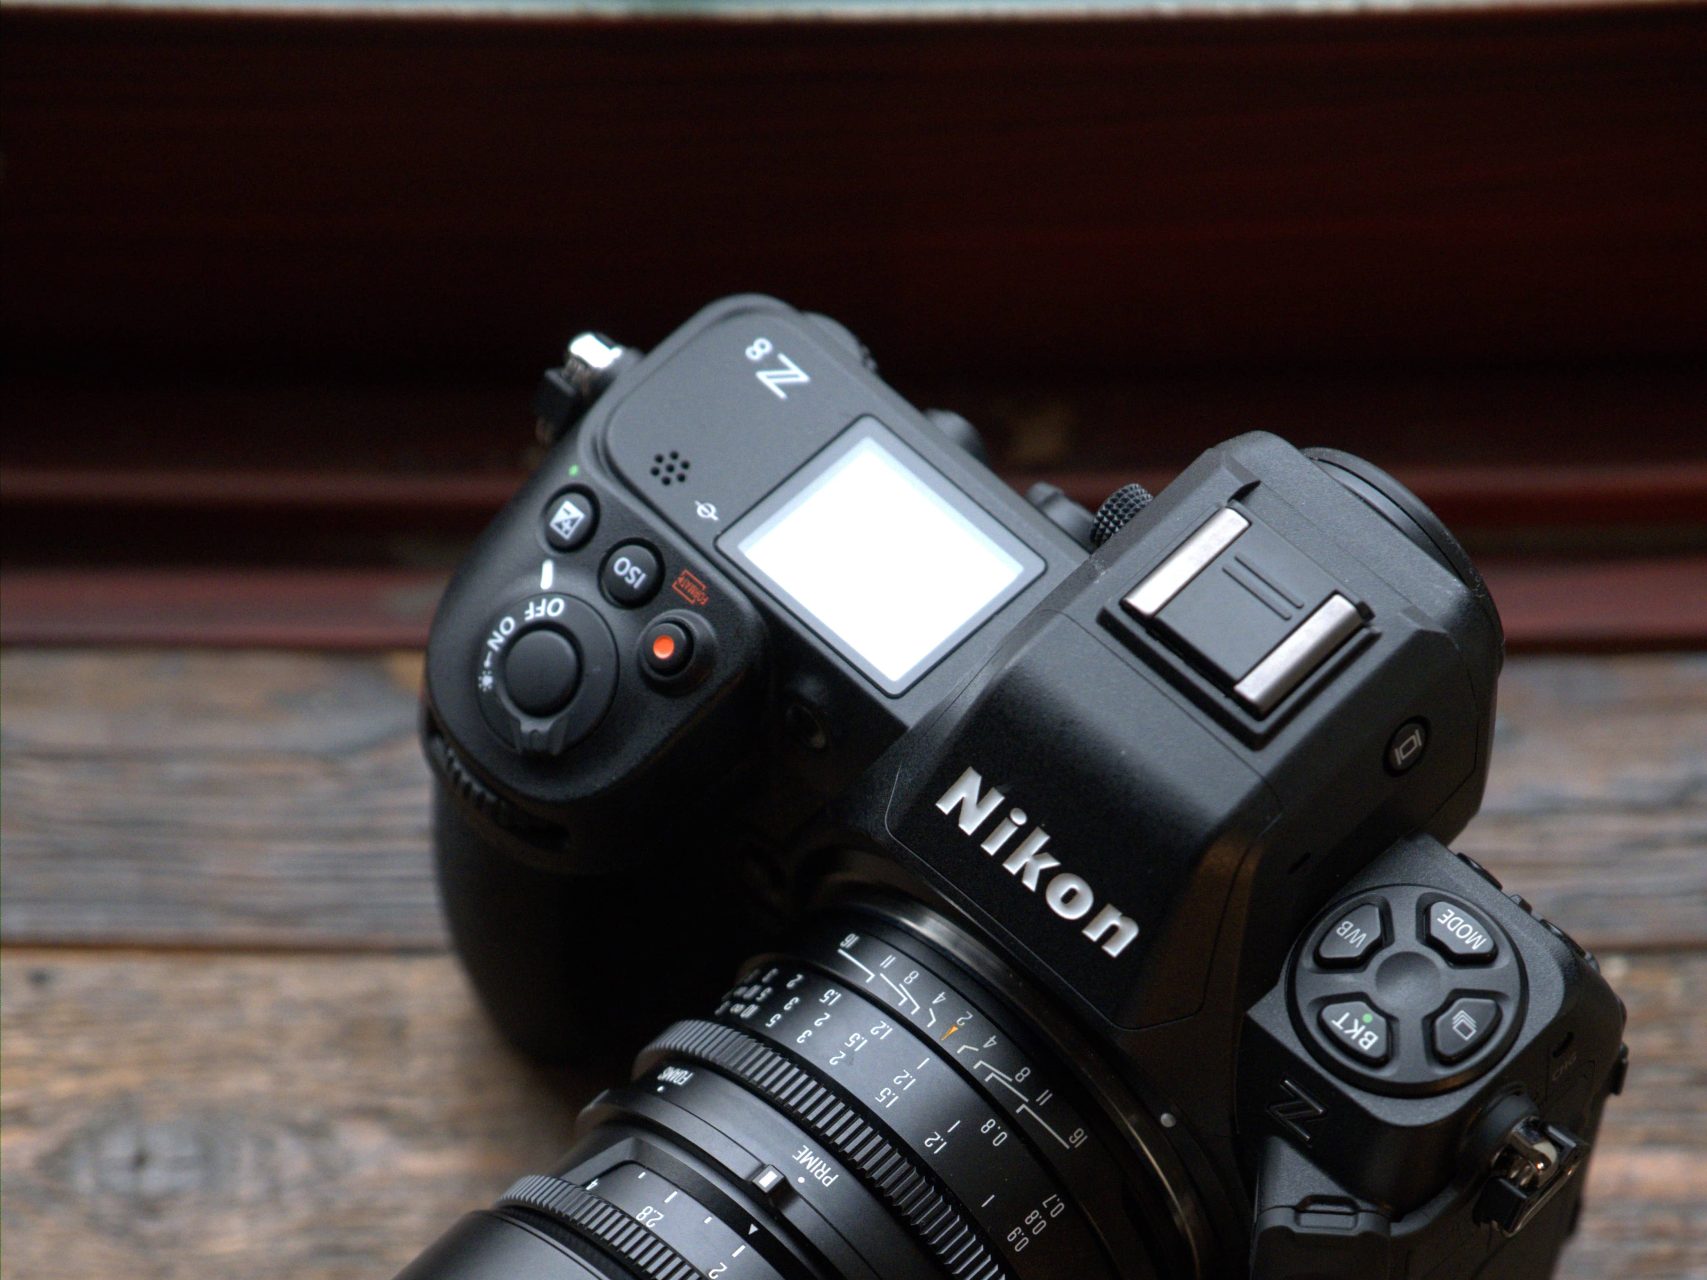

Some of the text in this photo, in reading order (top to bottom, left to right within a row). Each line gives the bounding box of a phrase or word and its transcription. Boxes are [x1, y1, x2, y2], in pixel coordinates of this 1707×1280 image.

[613, 556, 647, 589] ISO
[486, 598, 565, 651] OFF ON
[935, 766, 1140, 958] Nikon
[1336, 920, 1367, 949] WB
[1436, 908, 1487, 950] MODE
[903, 970, 920, 985] 8
[932, 991, 946, 1005] 4
[956, 1011, 974, 1026] 2
[982, 1035, 997, 1048] 4
[1014, 1066, 1031, 1083] 8
[1068, 1127, 1088, 1149] 16
[1332, 1012, 1379, 1051] BKT
[783, 996, 799, 1011] 3
[814, 1012, 831, 1027] 2
[844, 1032, 868, 1052] 1.5
[893, 1069, 916, 1091] 1.2
[1024, 1209, 1047, 1235] 0.8
[786, 973, 804, 989] 2
[818, 988, 841, 1006] 1.5
[870, 1020, 893, 1040] 1.2
[980, 1118, 1008, 1147] 0.8
[1042, 1193, 1065, 1218] 0.7
[765, 1013, 782, 1028] 5
[796, 1029, 813, 1044] 3
[829, 1050, 846, 1066] 2
[875, 1087, 899, 1108] 1.5
[924, 1131, 948, 1154] 1.2
[1006, 1226, 1030, 1252] 0.9
[792, 1145, 839, 1187] PRIME
[635, 1205, 664, 1228] 2.8
[708, 1262, 728, 1280] 2
